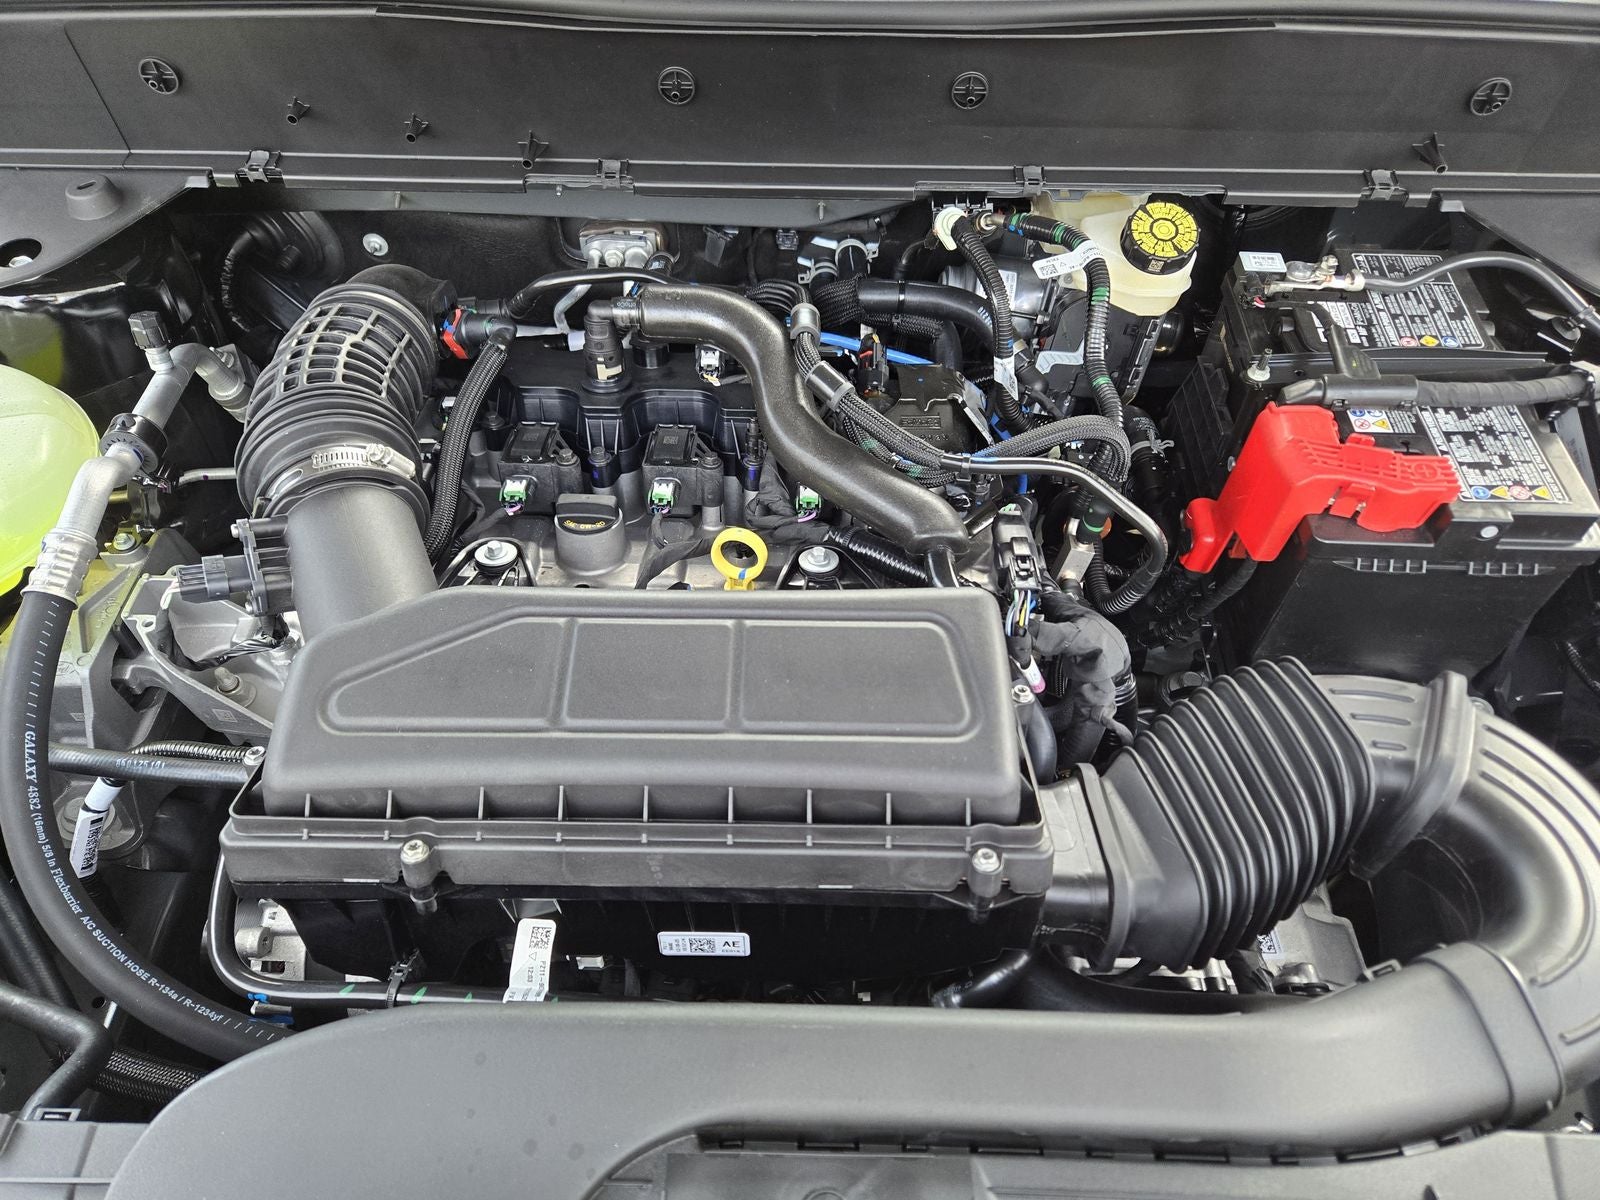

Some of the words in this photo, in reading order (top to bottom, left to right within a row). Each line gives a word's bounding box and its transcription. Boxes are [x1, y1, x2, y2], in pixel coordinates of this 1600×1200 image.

[25, 731, 37, 783] GALAXY
[27, 785, 41, 811] 4882
[31, 812, 49, 844] (16mm)
[41, 844, 54, 858] 5/8
[50, 867, 83, 914] Flexbarrier
[80, 915, 96, 930] A/C
[92, 929, 128, 963] SUCTION
[722, 940, 741, 948] AE
[124, 959, 151, 981] HOSE
[148, 977, 179, 1000] R-134a
[182, 998, 225, 1022] R-1234yf
